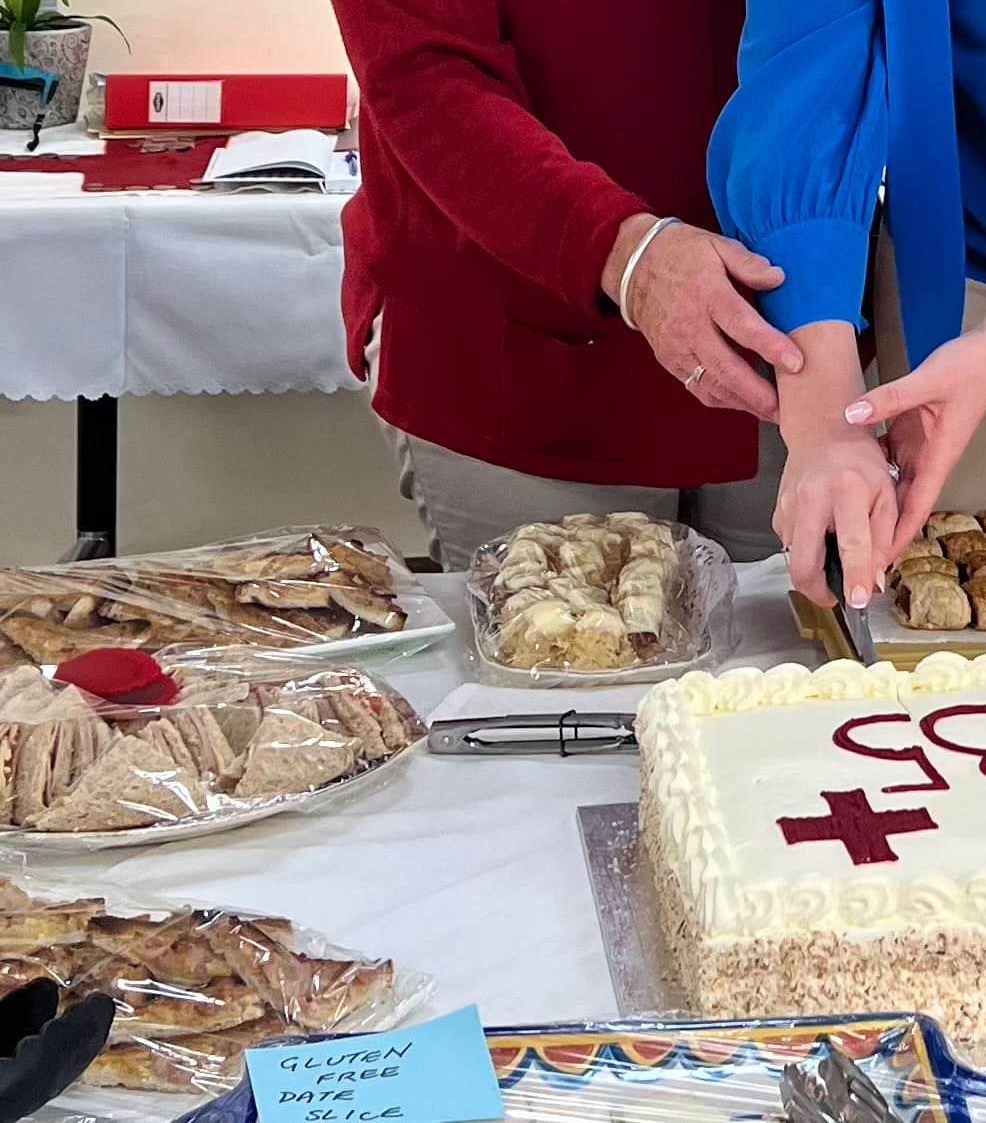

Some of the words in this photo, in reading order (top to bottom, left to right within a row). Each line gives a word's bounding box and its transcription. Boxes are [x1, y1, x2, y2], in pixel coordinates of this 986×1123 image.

[279, 1041, 413, 1073] GLUTEN
[316, 1065, 401, 1086] FREE
[278, 1089, 356, 1105] DATE
[304, 1106, 405, 1122] SLICE
